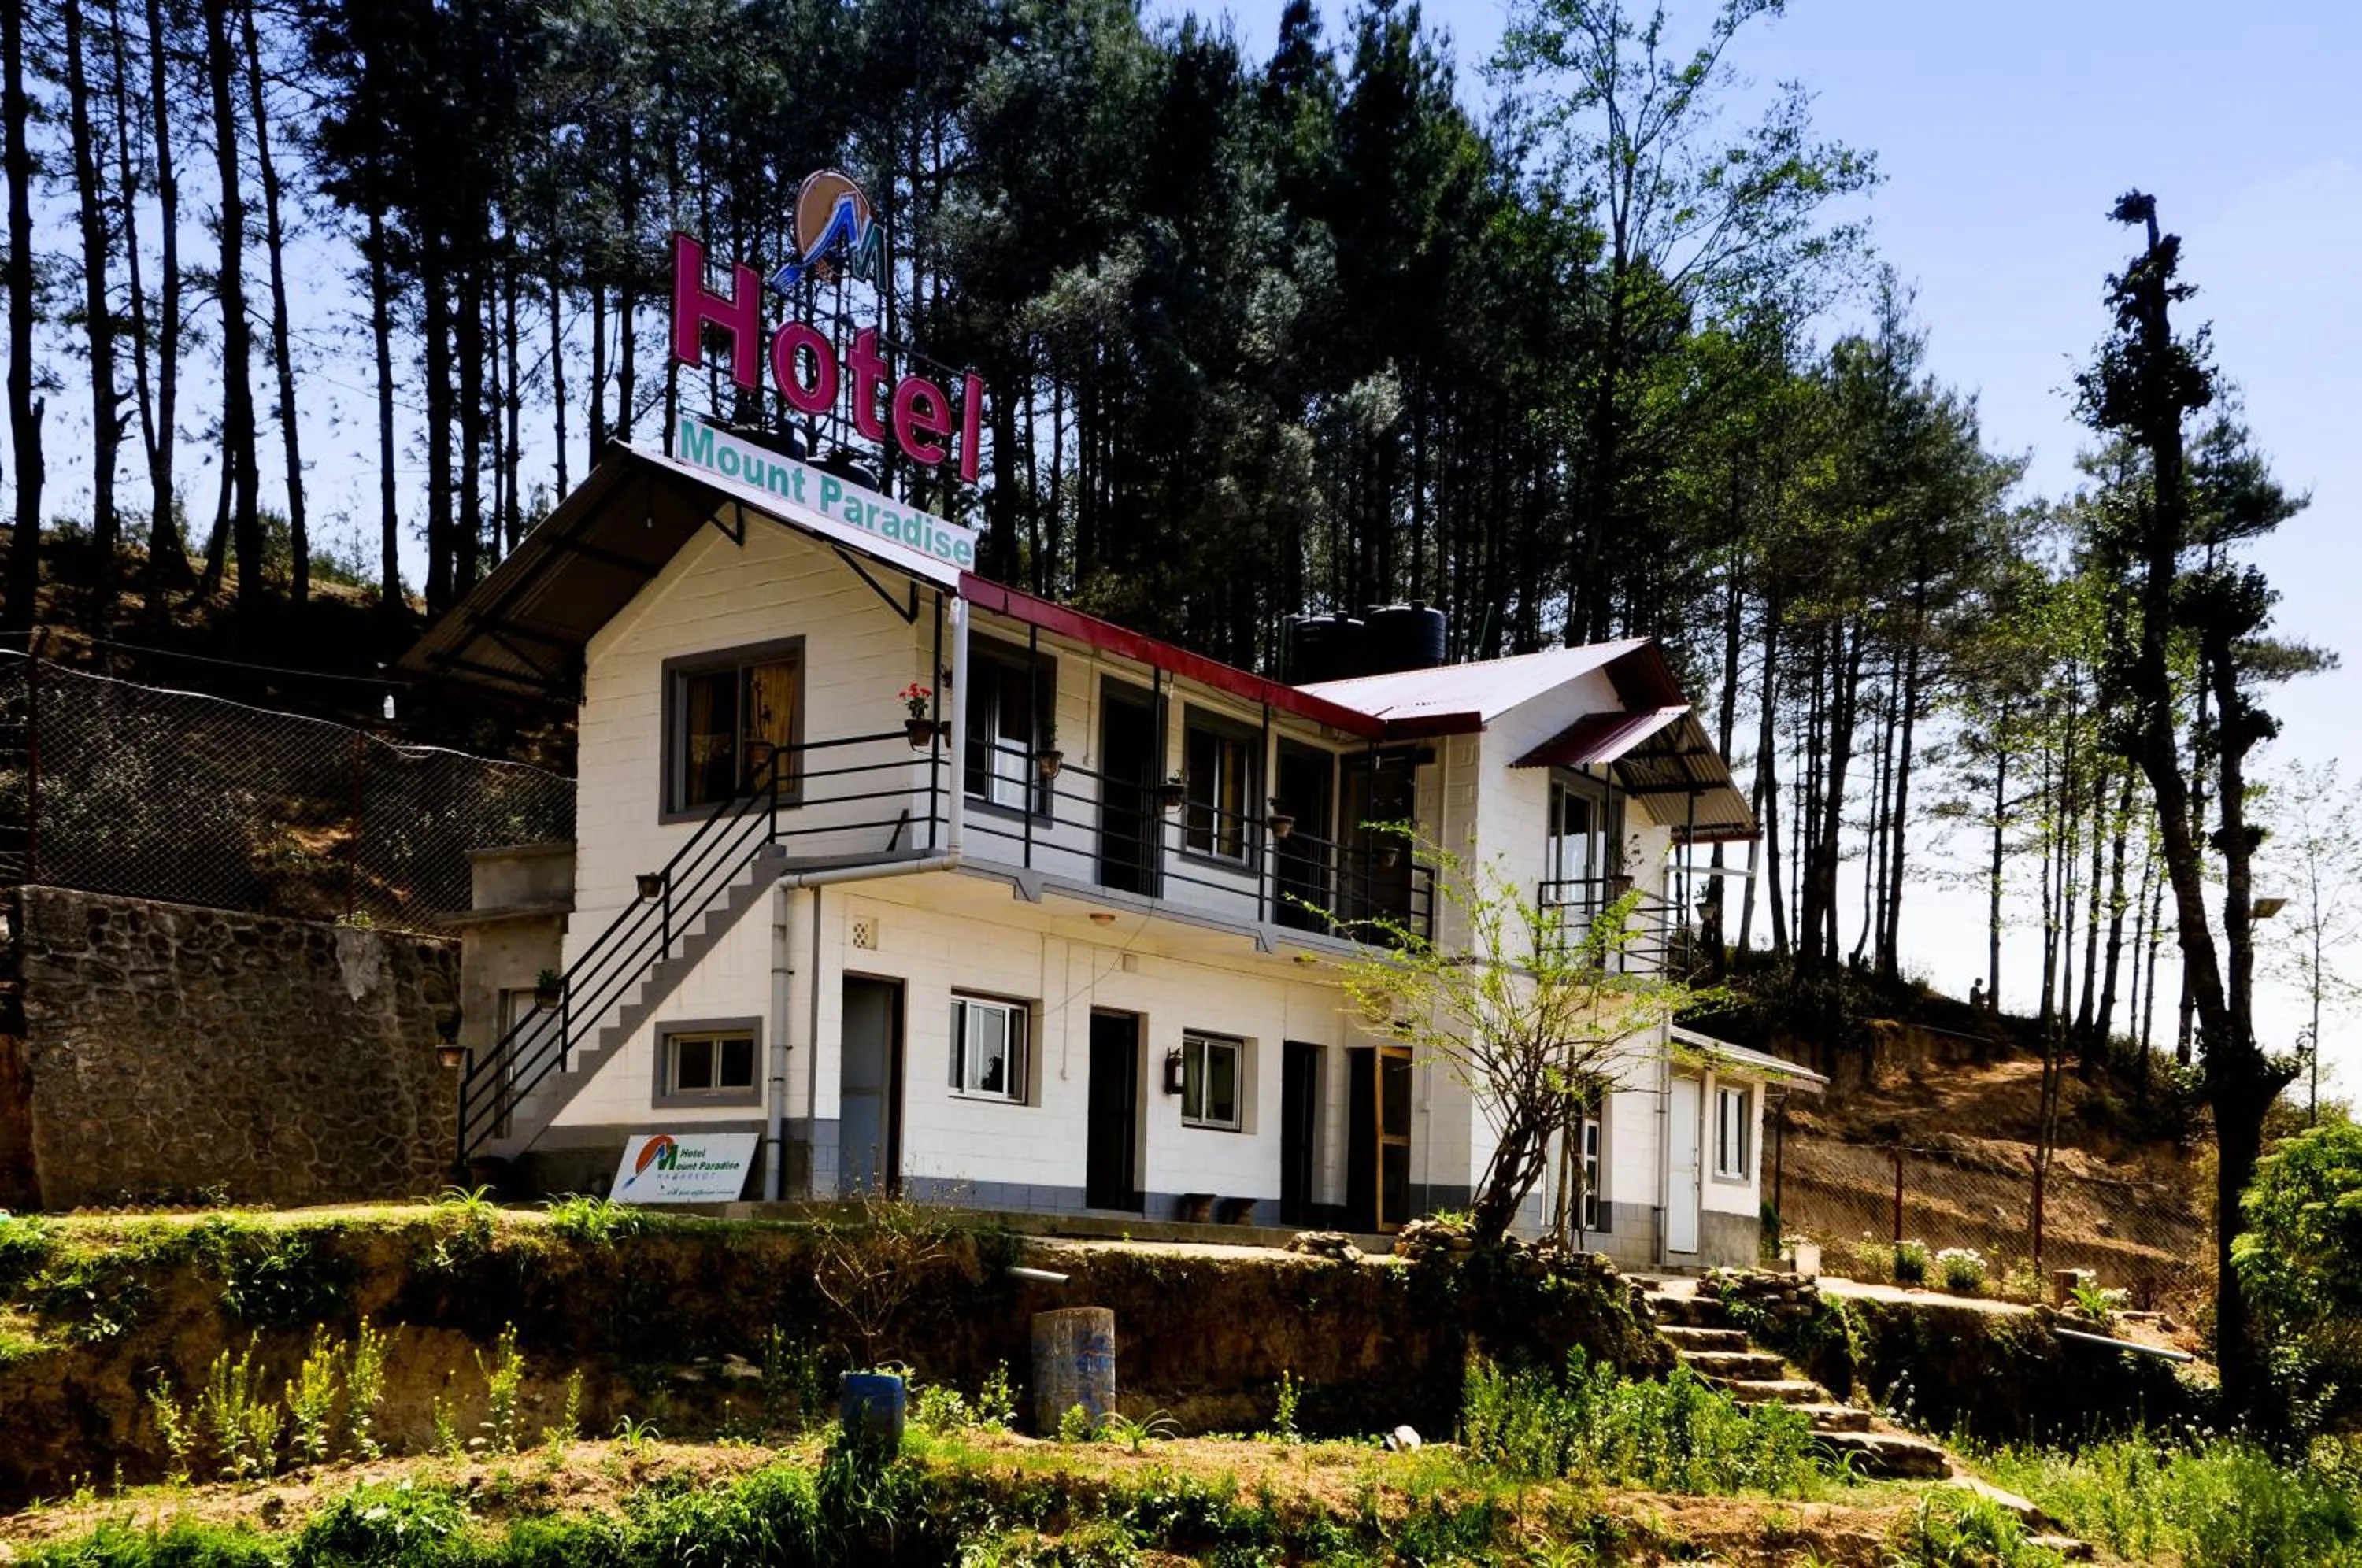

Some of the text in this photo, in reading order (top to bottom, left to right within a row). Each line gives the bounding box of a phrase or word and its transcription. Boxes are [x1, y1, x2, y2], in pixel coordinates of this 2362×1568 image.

[673, 231, 983, 483] Hotel
[680, 420, 973, 566] Mount Paradise
[679, 1148, 706, 1158] Hotel
[699, 1160, 740, 1170] Paradise
